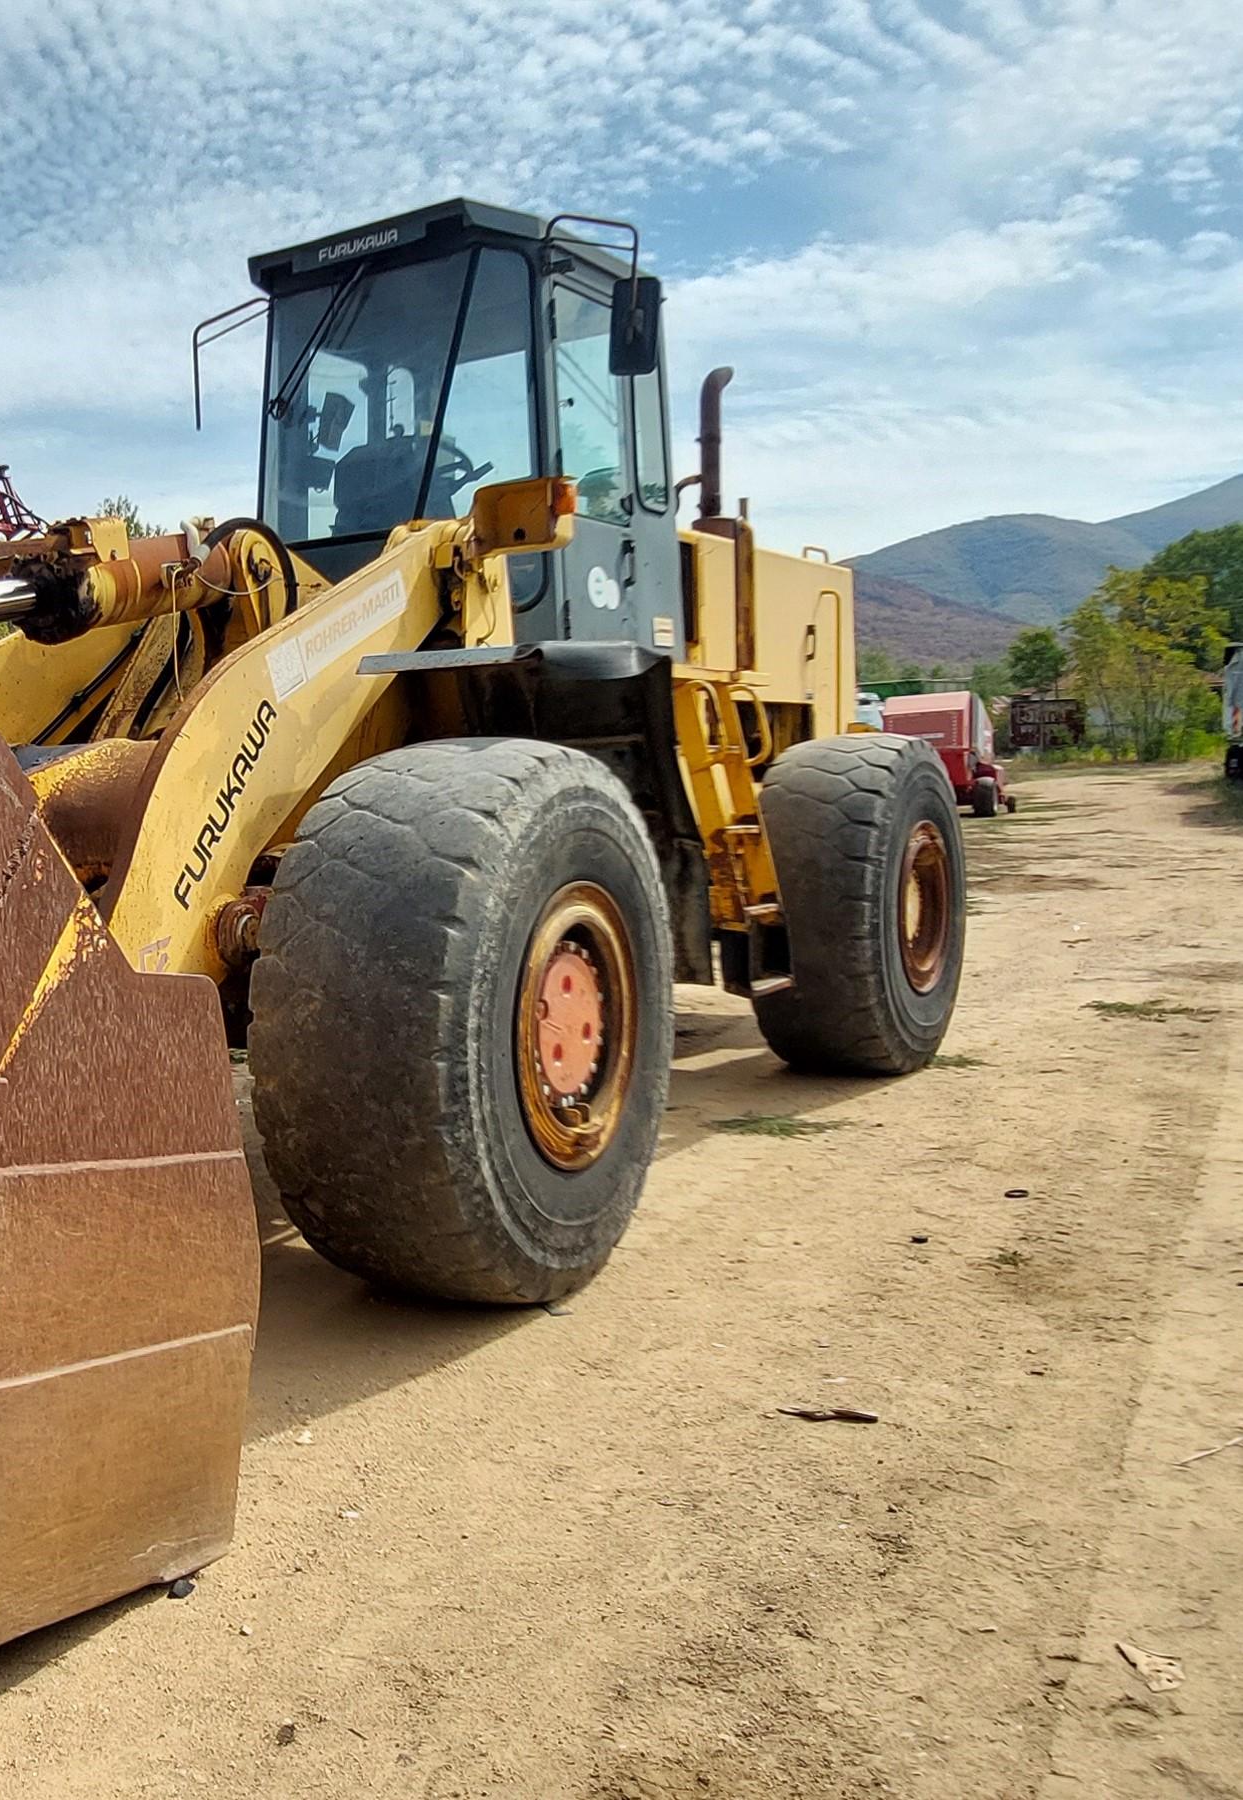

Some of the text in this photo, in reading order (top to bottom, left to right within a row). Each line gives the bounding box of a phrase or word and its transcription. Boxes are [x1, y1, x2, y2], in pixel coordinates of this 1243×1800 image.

[318, 228, 398, 262] FURUKAWA
[305, 580, 400, 661] ROHRER-MARTI
[174, 699, 278, 910] FURUKAWA
